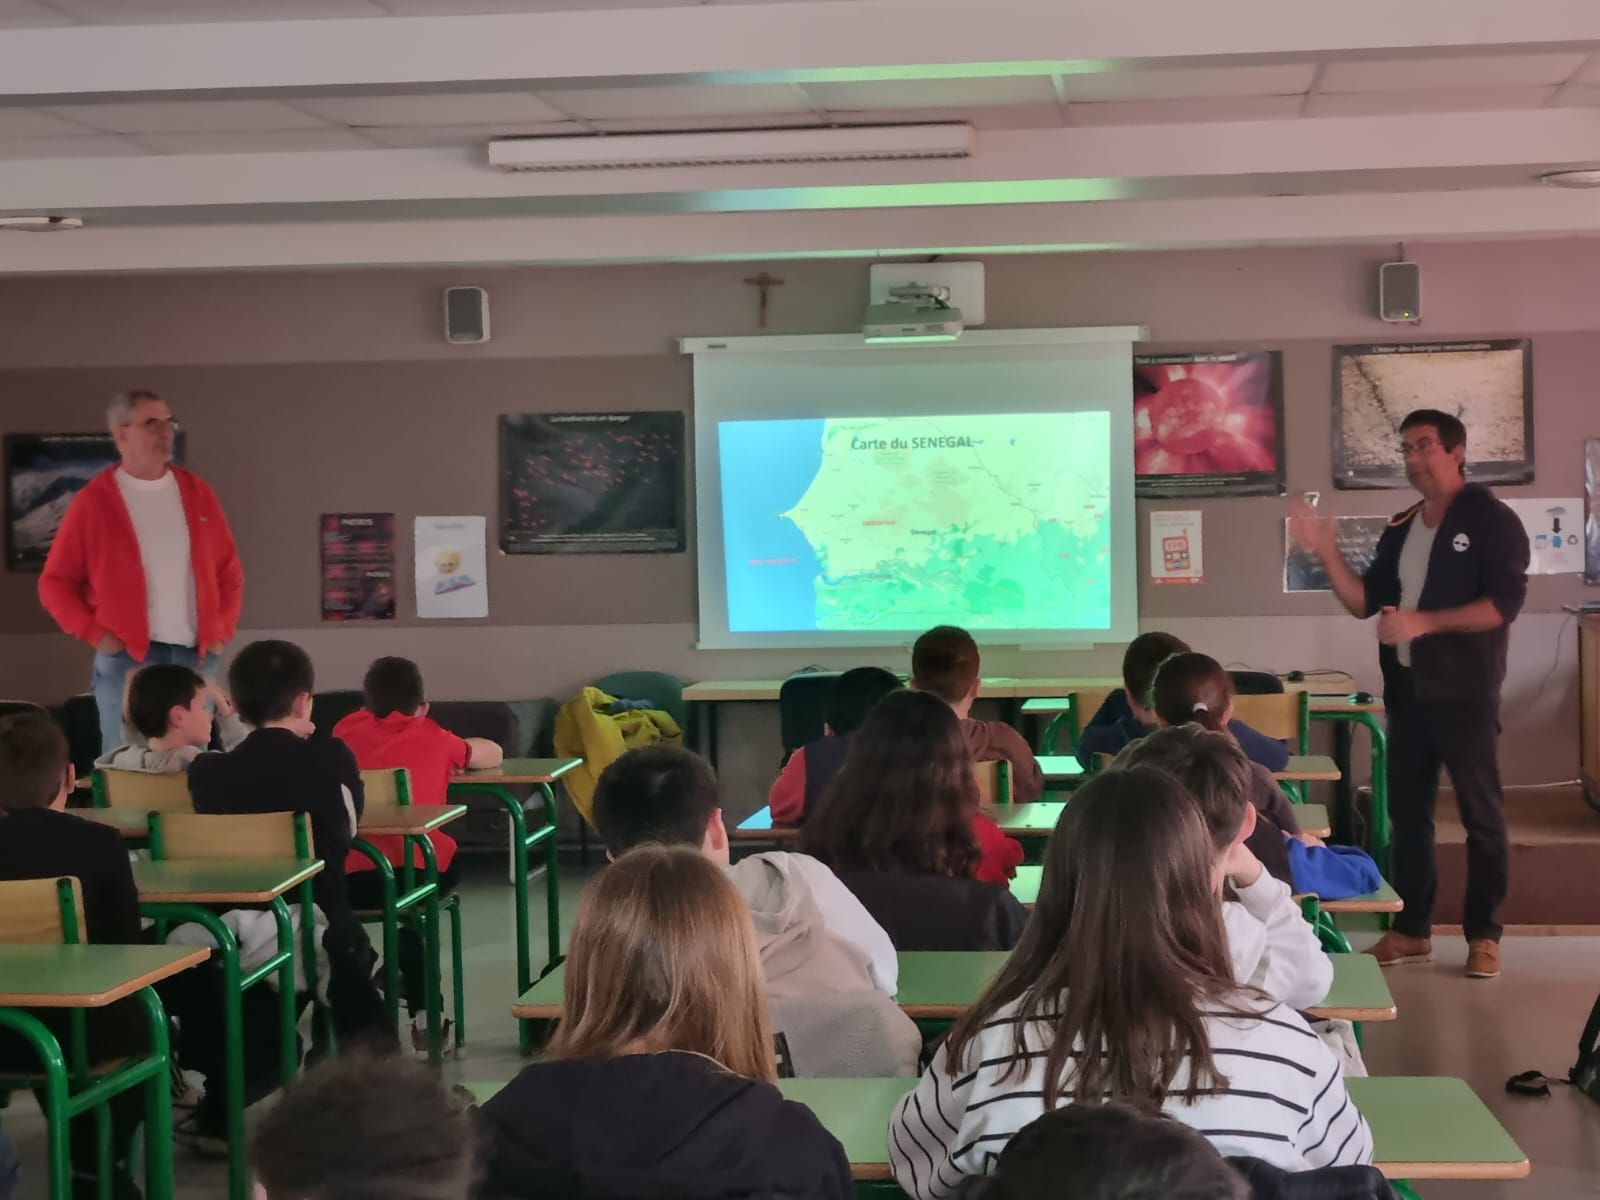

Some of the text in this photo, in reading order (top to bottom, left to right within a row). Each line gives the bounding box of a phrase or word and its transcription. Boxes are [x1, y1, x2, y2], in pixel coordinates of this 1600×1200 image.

[851, 435, 975, 450] Carte du SENEGAL
